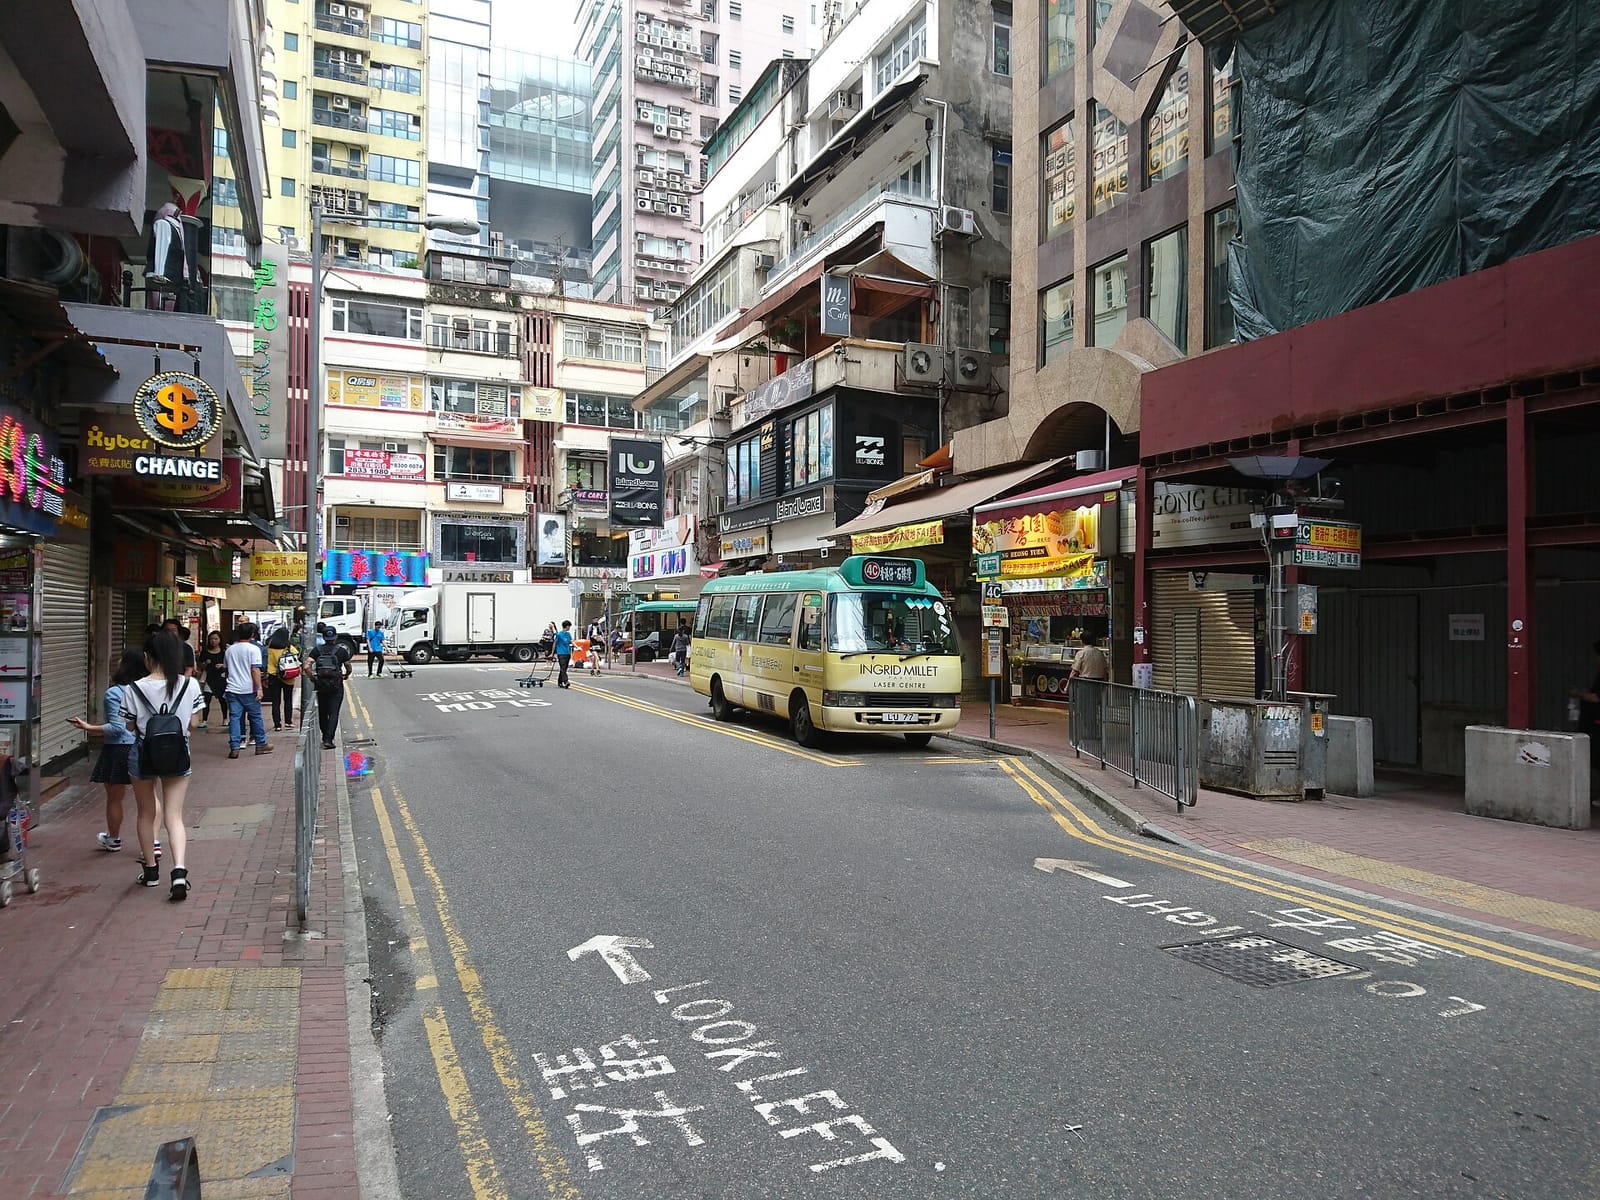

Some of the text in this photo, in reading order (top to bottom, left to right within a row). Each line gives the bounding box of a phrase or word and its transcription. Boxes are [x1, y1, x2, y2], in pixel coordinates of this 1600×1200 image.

[135, 456, 219, 479] CHANGE
[255, 568, 279, 577] PHONE
[456, 572, 479, 581] ALL
[481, 573, 511, 582] STAR
[866, 564, 878, 577] 4C
[986, 586, 1001, 598] 4C
[859, 663, 939, 677] INGRID MILLET
[434, 698, 553, 713] SLOW
[903, 713, 915, 721] 77
[654, 979, 906, 1174] LOOK LEFT
